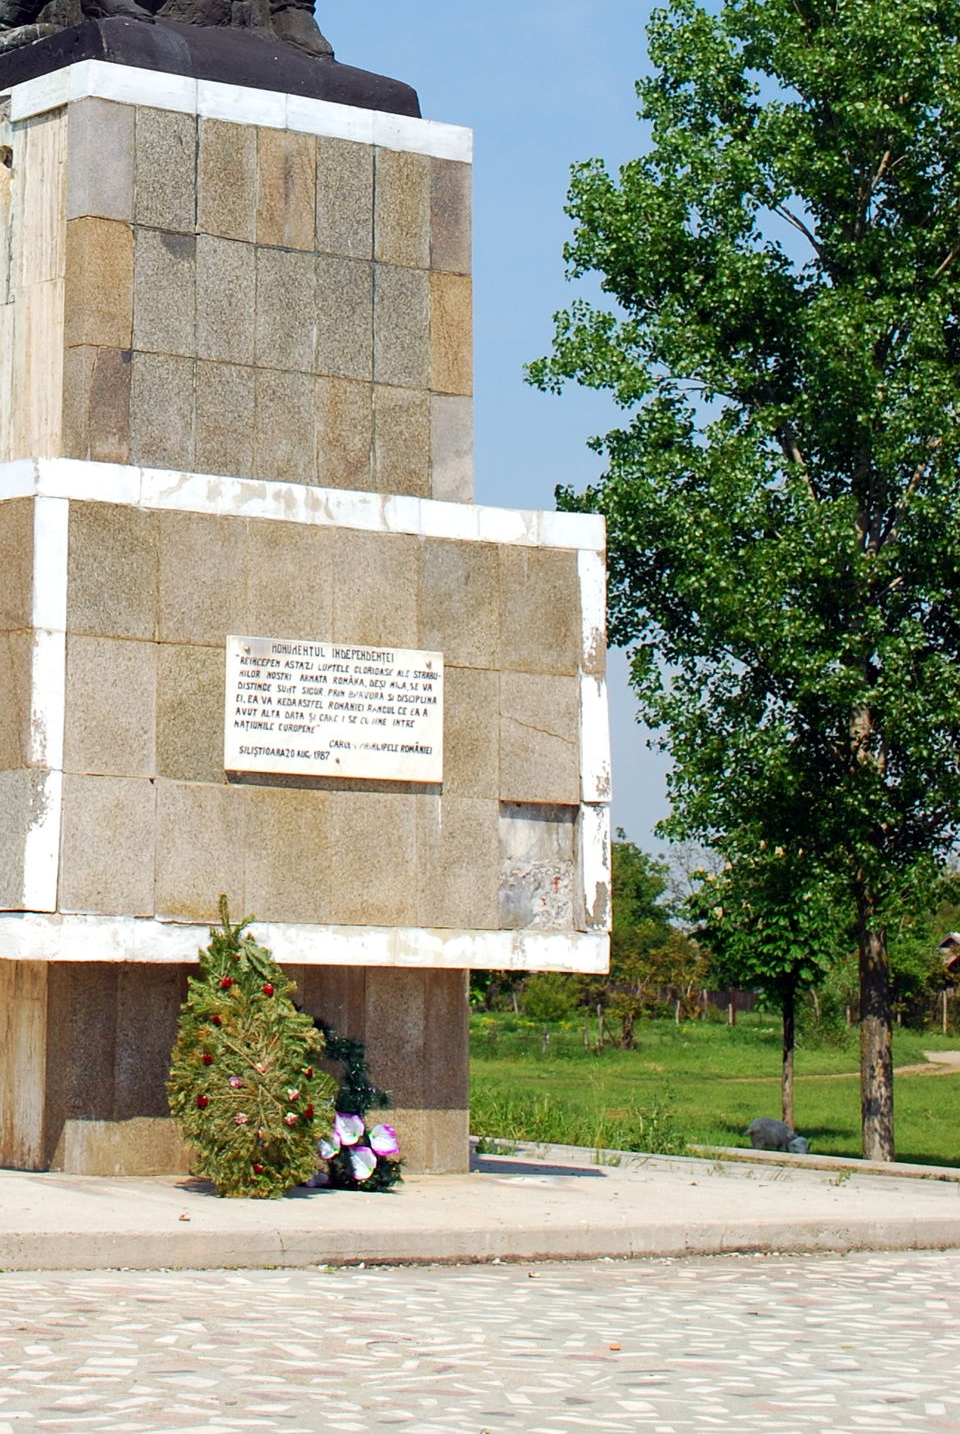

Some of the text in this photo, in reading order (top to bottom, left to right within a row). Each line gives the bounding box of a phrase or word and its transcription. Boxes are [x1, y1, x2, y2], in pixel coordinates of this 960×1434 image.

[272, 644, 325, 658] MONUMENTUL
[284, 660, 314, 670] ASTAZI
[318, 663, 350, 673] LUPTELE
[397, 670, 410, 678] ALE
[266, 672, 292, 680] NOSTRI
[300, 674, 328, 684] ARMATA
[422, 683, 432, 692] VA
[238, 681, 272, 692] DISTINGE
[276, 684, 296, 694] SUNT
[328, 688, 345, 697] PRIN
[396, 694, 438, 705] DISCIPLINA
[248, 694, 258, 704] EA
[261, 696, 272, 705] VA
[398, 706, 407, 716] CE
[410, 707, 420, 716] EA
[422, 708, 428, 717] A
[235, 706, 258, 716] AVUT
[260, 709, 280, 718] ALTA
[284, 710, 304, 720] DATA
[348, 715, 358, 724] SE
[392, 718, 416, 728] INTRE
